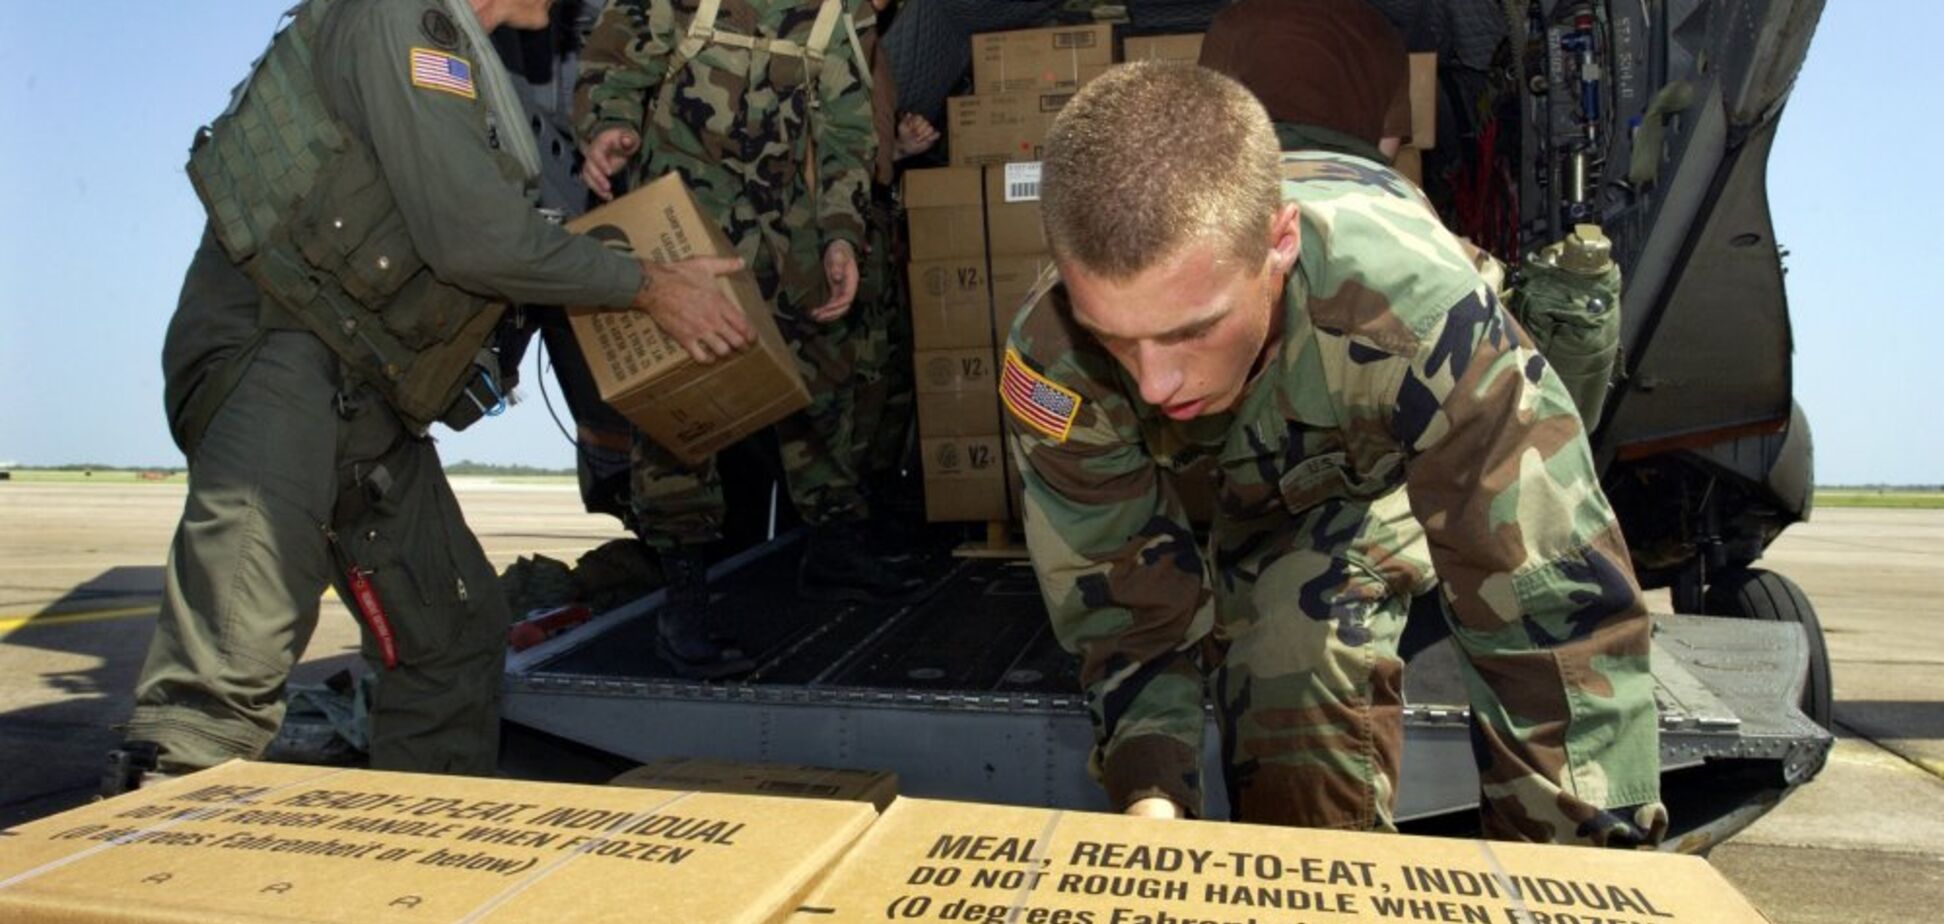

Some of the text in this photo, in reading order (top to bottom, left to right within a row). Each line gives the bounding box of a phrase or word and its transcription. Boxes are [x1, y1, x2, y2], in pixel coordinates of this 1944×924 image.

[221, 809, 342, 827] ROUGH
[328, 814, 465, 838] HANDLE
[455, 825, 560, 849] WHEN
[556, 836, 695, 864] FROZEN
[525, 806, 746, 846] INDIVIDUAL
[206, 831, 387, 858] Fahrenheit
[374, 848, 427, 862] or
[416, 847, 539, 876] below)
[927, 834, 1676, 918] MEAL, READY-TO-EAT, INDIVIDUAL
[886, 896, 932, 920] (0
[907, 866, 962, 886] DO
[971, 868, 1050, 890] NOT
[1057, 873, 1189, 900] ROUGH
[1204, 883, 1359, 914] HANDLE
[1371, 896, 1490, 924] WHEN
